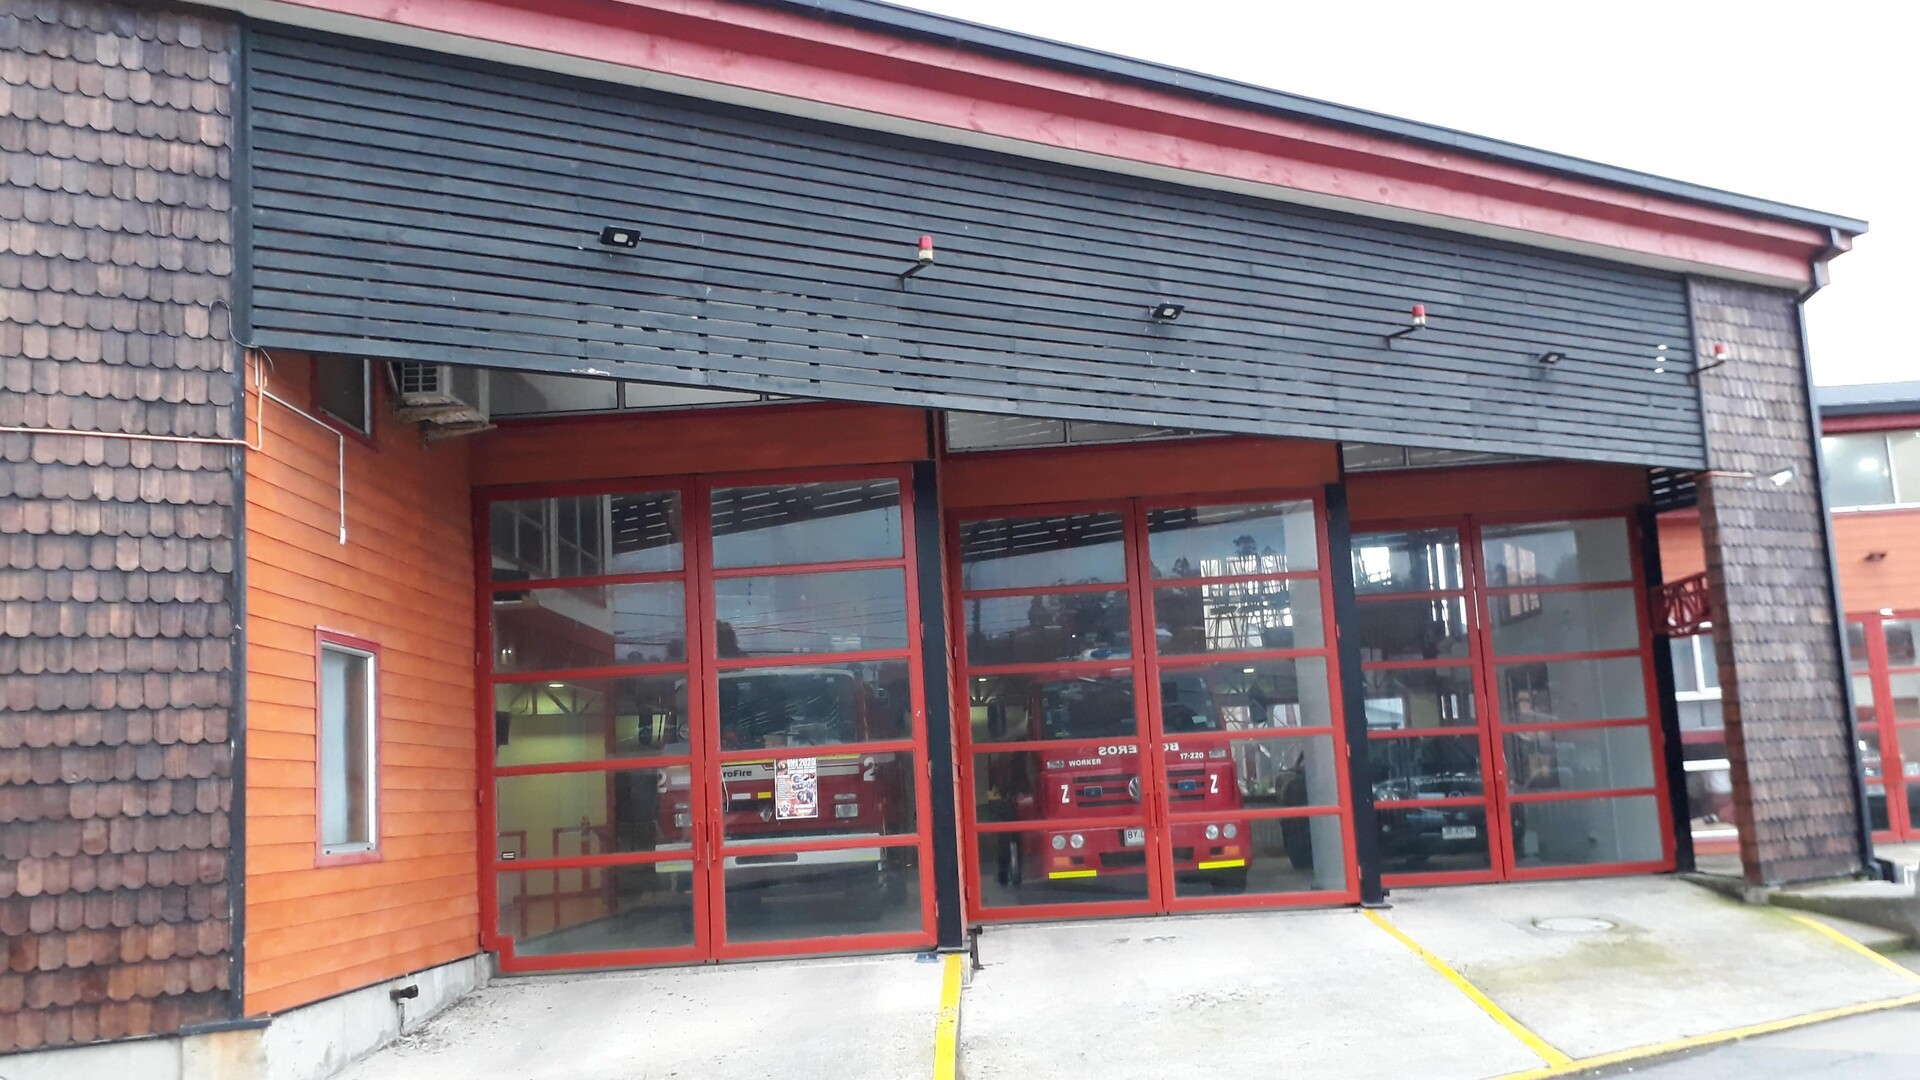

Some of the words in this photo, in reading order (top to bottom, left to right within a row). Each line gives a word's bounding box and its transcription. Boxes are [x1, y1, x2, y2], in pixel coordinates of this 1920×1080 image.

[799, 757, 817, 767] 2020
[1068, 758, 1102, 767] WORKER
[723, 769, 753, 779] roFire
[863, 756, 875, 782] 2
